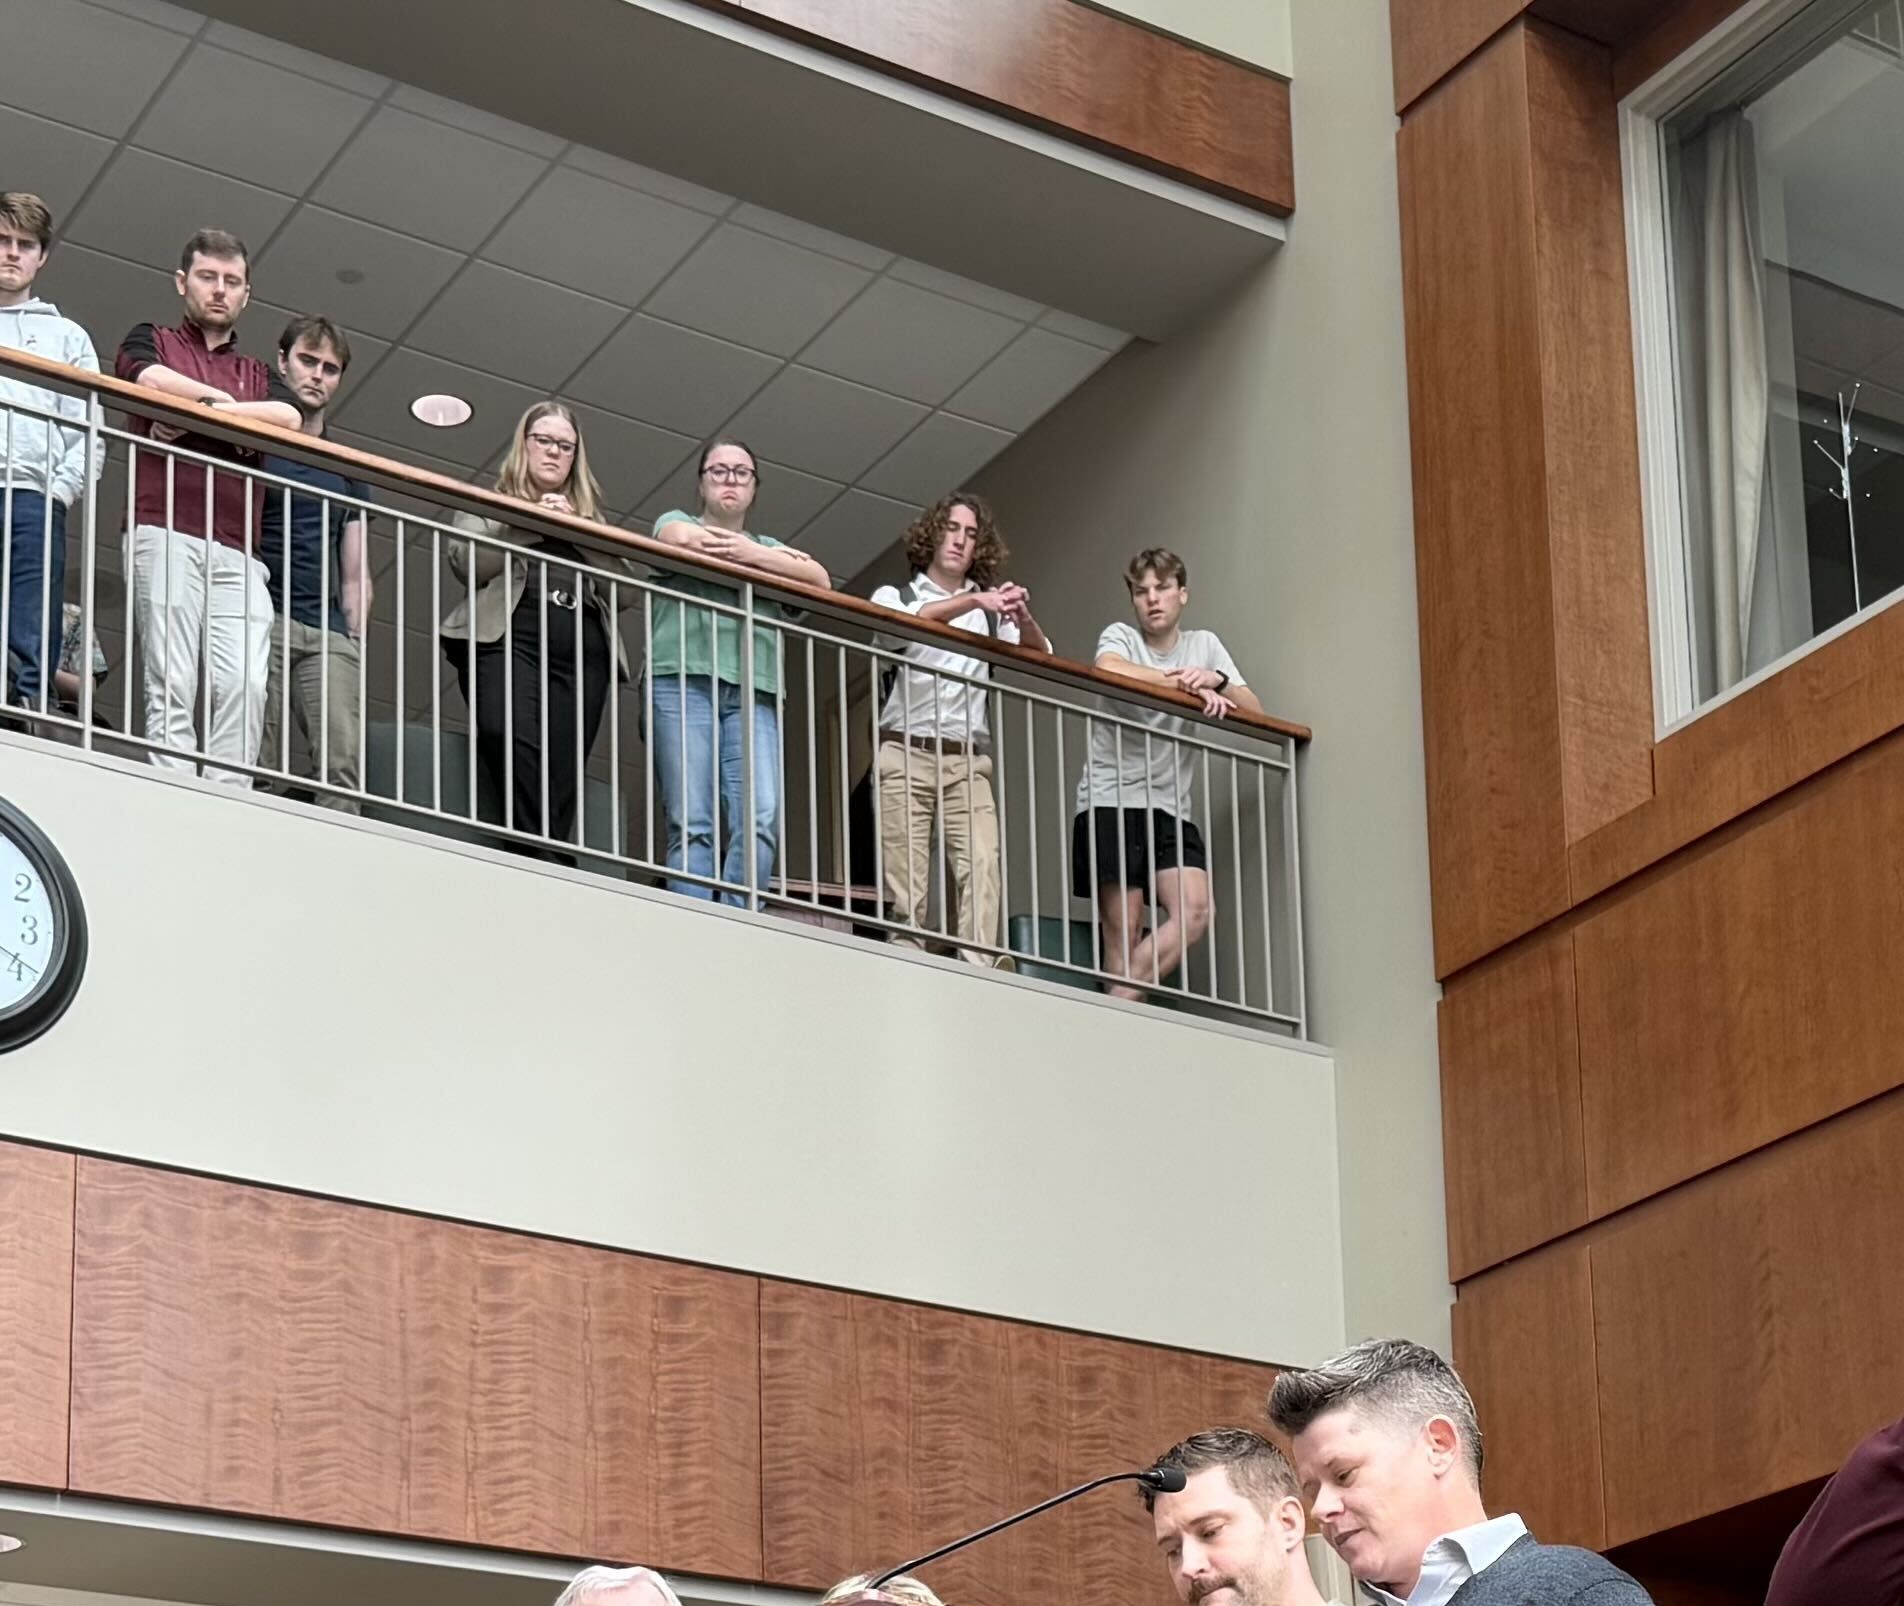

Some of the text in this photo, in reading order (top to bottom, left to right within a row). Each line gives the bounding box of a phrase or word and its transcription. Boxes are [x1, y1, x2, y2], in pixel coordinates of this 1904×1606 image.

[13, 872, 32, 903] 2
[20, 914, 39, 946] 3
[7, 952, 24, 982] 4
